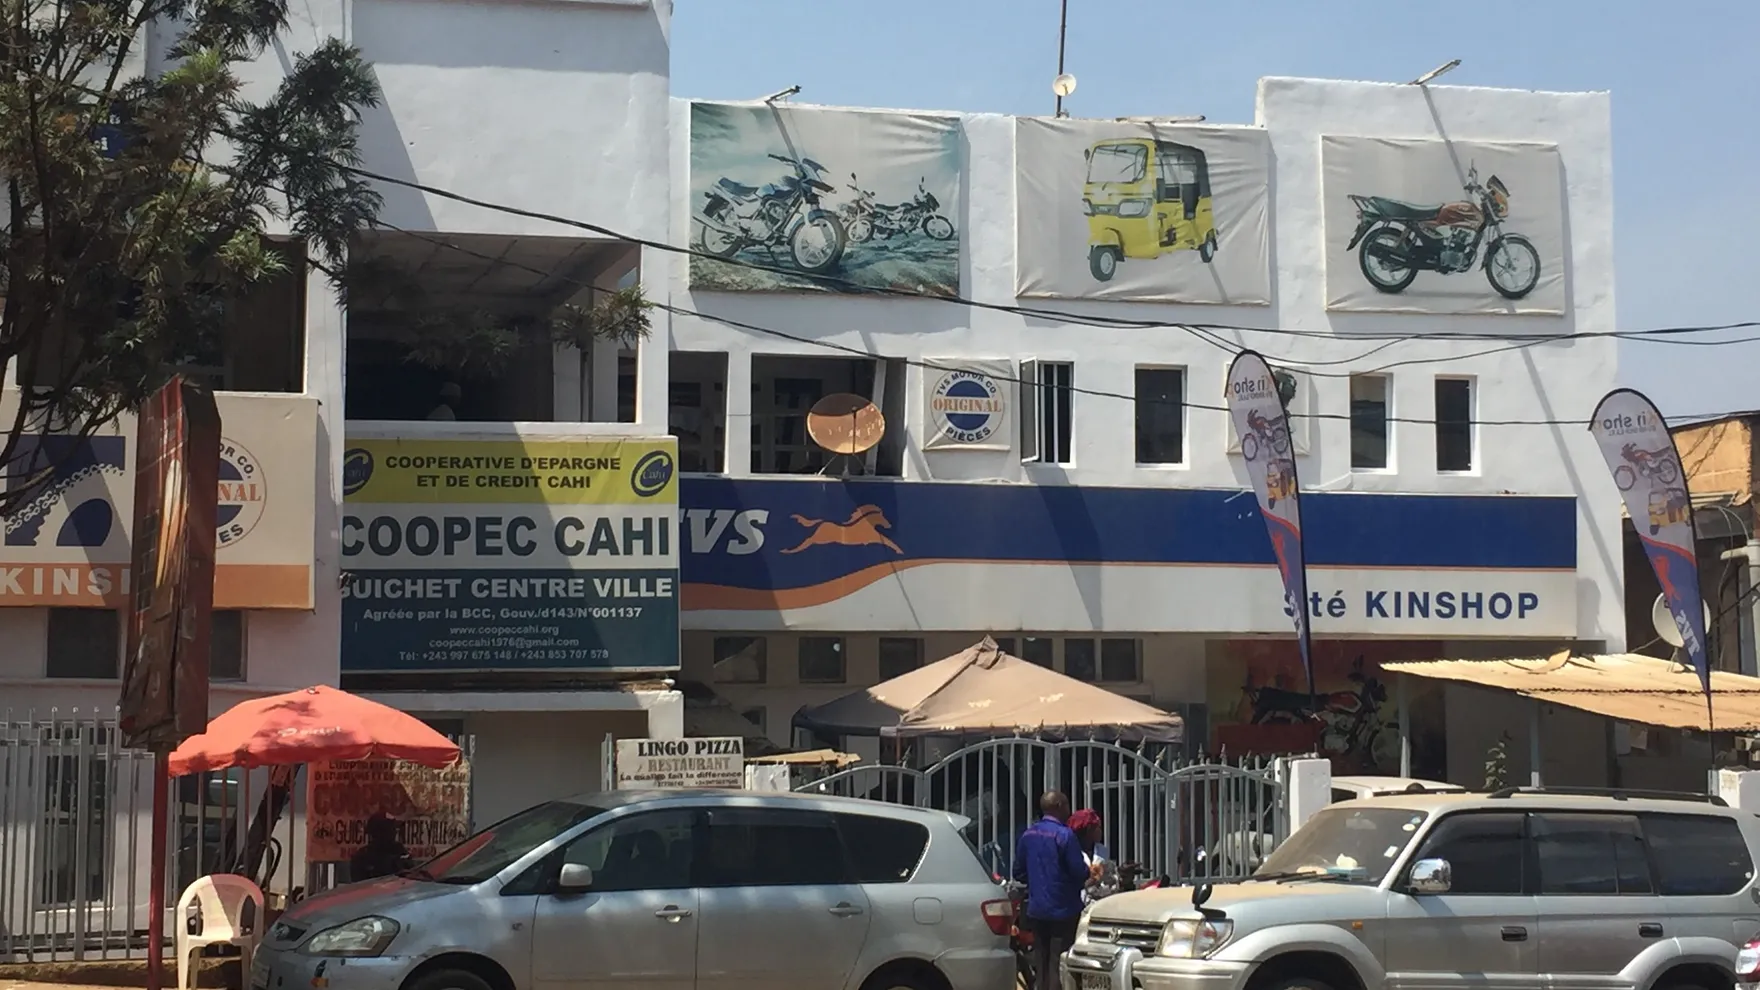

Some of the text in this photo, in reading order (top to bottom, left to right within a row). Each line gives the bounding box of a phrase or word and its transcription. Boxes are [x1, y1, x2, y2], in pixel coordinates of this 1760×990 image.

[936, 379, 950, 395] TVS
[951, 370, 985, 382] MOTOR
[933, 398, 1002, 412] ORIGINAL
[946, 426, 991, 442] PIÈCES
[385, 456, 621, 470] COOPERATIVE D'EPARGNE
[417, 475, 591, 488] ET DE CREDIT CAHI
[218, 483, 262, 501] NAL
[218, 524, 244, 543] ES
[341, 515, 670, 557] COOPEC CAHI
[680, 508, 770, 555] VS
[471, 578, 585, 598] CENTRE
[593, 577, 673, 597] VILLE
[363, 608, 414, 621] Agréée
[418, 609, 441, 621] par
[445, 608, 457, 619] la
[462, 608, 496, 620] BCC,
[1366, 591, 1539, 620] KINSHOP
[422, 651, 447, 661] +243
[521, 650, 546, 660] +243
[637, 739, 742, 757] LINGO PIZZA
[647, 757, 731, 772] RESTAURANT
